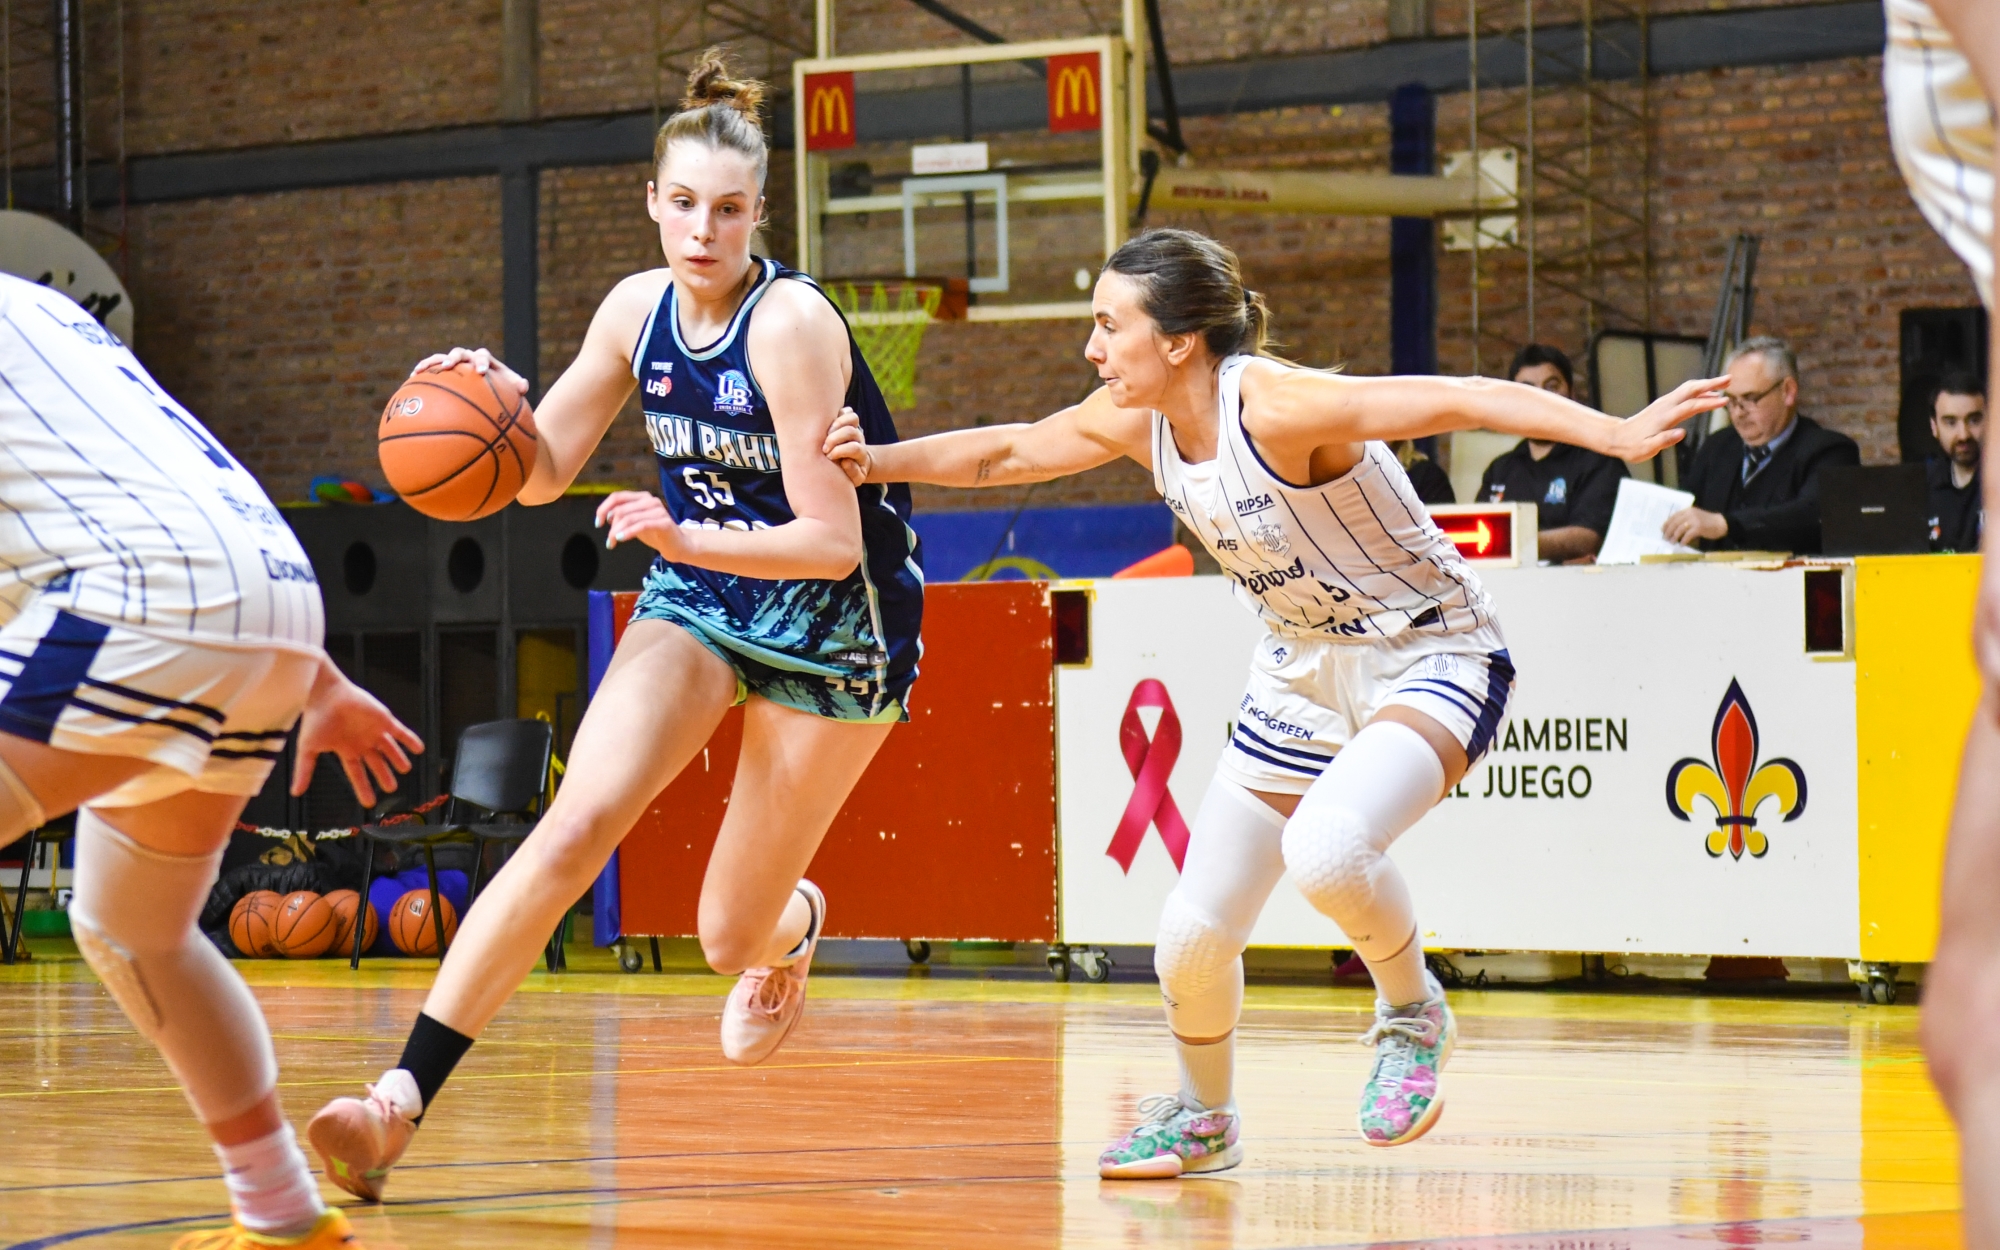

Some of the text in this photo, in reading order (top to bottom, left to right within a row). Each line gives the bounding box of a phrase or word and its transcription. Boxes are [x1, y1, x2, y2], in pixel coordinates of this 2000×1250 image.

[646, 379, 667, 397] LFB
[696, 420, 780, 473] BAHI
[683, 467, 735, 509] 55
[1236, 493, 1274, 513] RIPSA
[1494, 718, 1628, 751] AMBIEN
[1483, 765, 1592, 798] JUEGO
